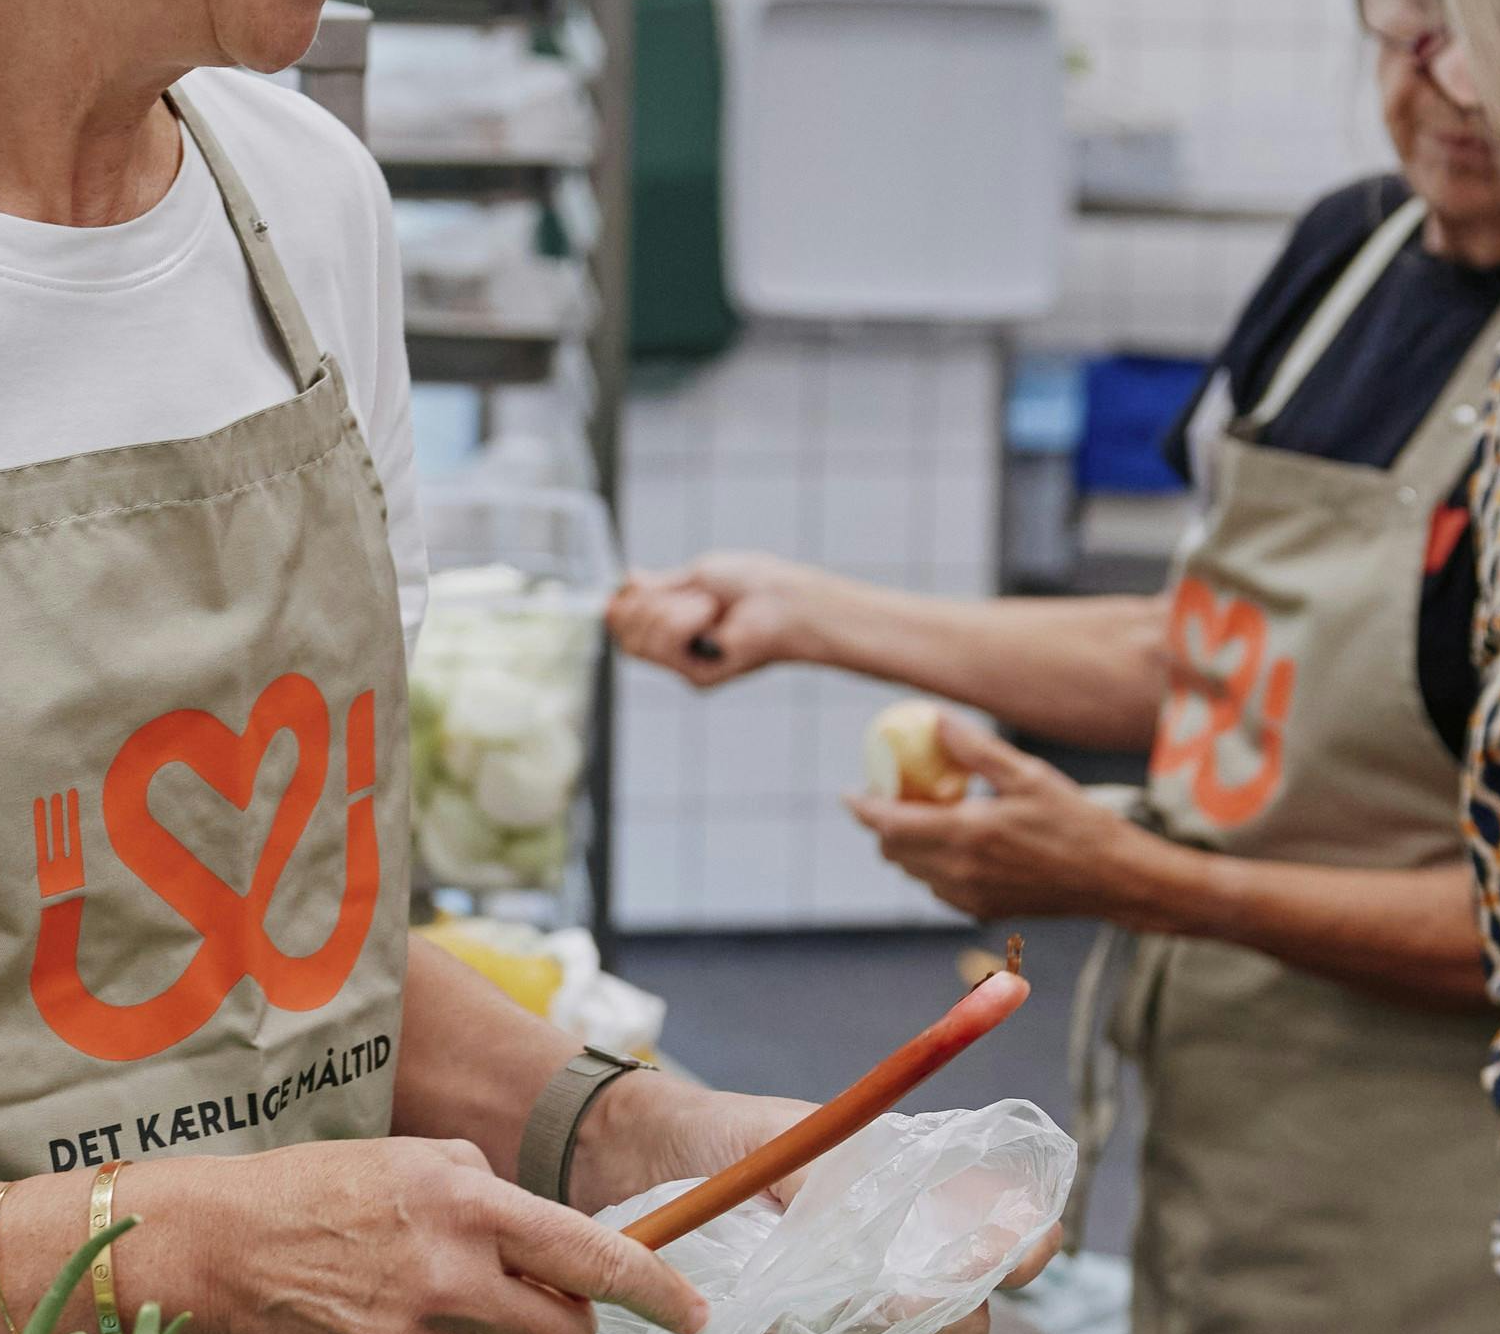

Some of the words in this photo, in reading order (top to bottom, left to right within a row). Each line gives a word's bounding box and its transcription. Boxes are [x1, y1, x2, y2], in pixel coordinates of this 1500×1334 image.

[48, 1123, 122, 1174] DET
[136, 1077, 292, 1153] KÆRLIGE
[296, 1033, 392, 1100] MÅLTID
